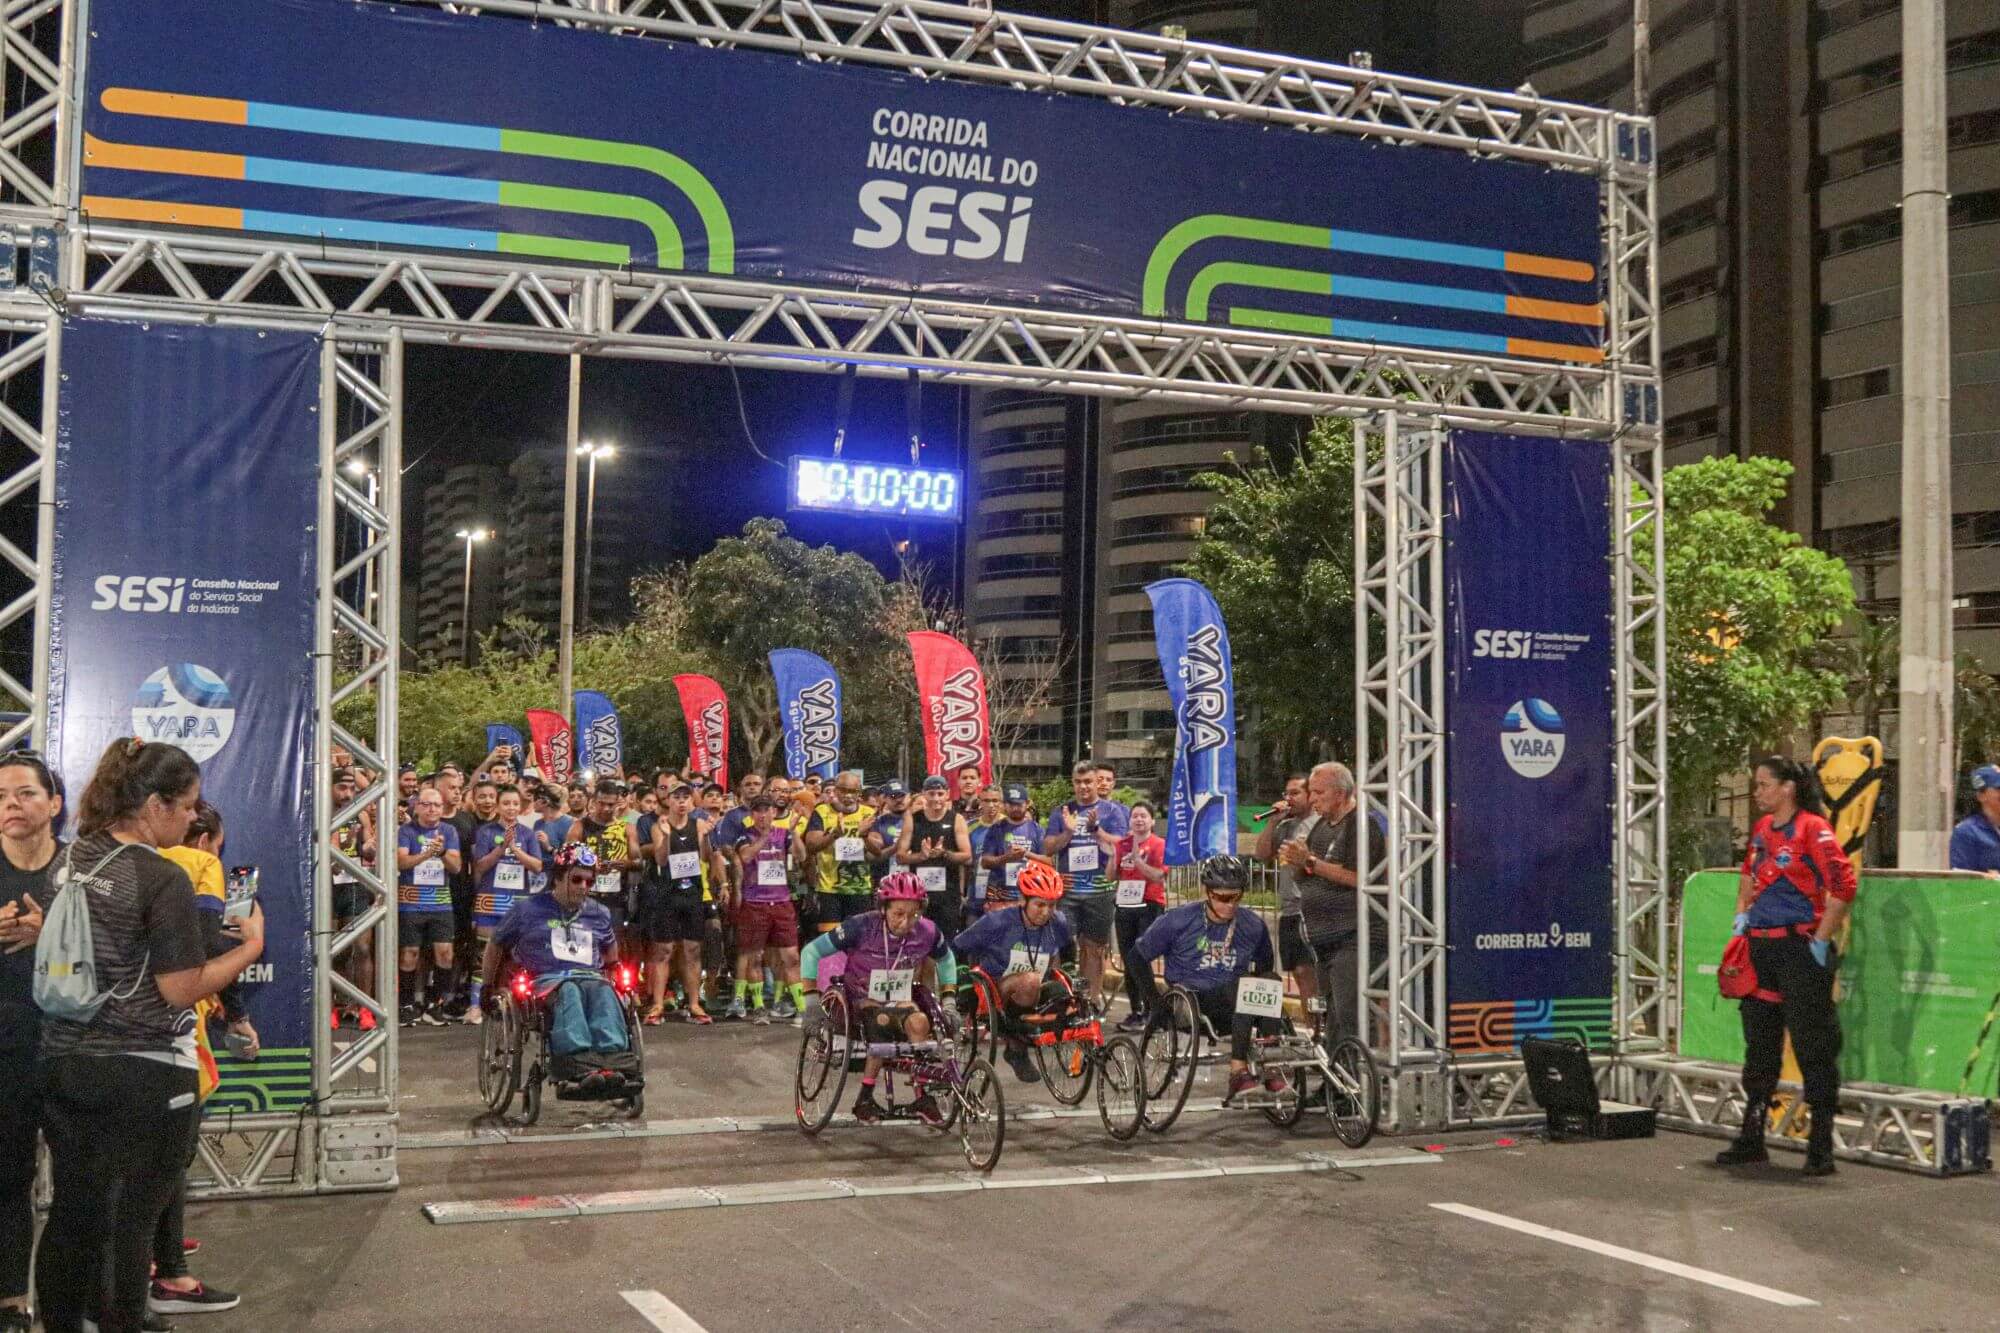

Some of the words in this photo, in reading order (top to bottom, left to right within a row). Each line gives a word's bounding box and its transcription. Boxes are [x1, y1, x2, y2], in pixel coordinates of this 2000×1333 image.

[872, 108, 988, 149] CORRIDA
[866, 141, 995, 183] NACIONAL
[1000, 158, 1038, 187] DO
[192, 579, 236, 589] Conselho
[237, 580, 280, 591] Nacional
[203, 591, 235, 603] Serviço
[237, 592, 263, 602] Social
[200, 604, 240, 614] Indústria
[1186, 624, 1227, 753] YARA
[147, 715, 220, 738] YARA
[800, 680, 837, 768] YARA
[944, 669, 982, 771] YARA
[592, 715, 619, 776] YARA
[1510, 738, 1556, 757] YARA
[1475, 933, 1525, 949] CORRER
[1526, 932, 1548, 948] FAZ
[1565, 932, 1591, 947] BEM
